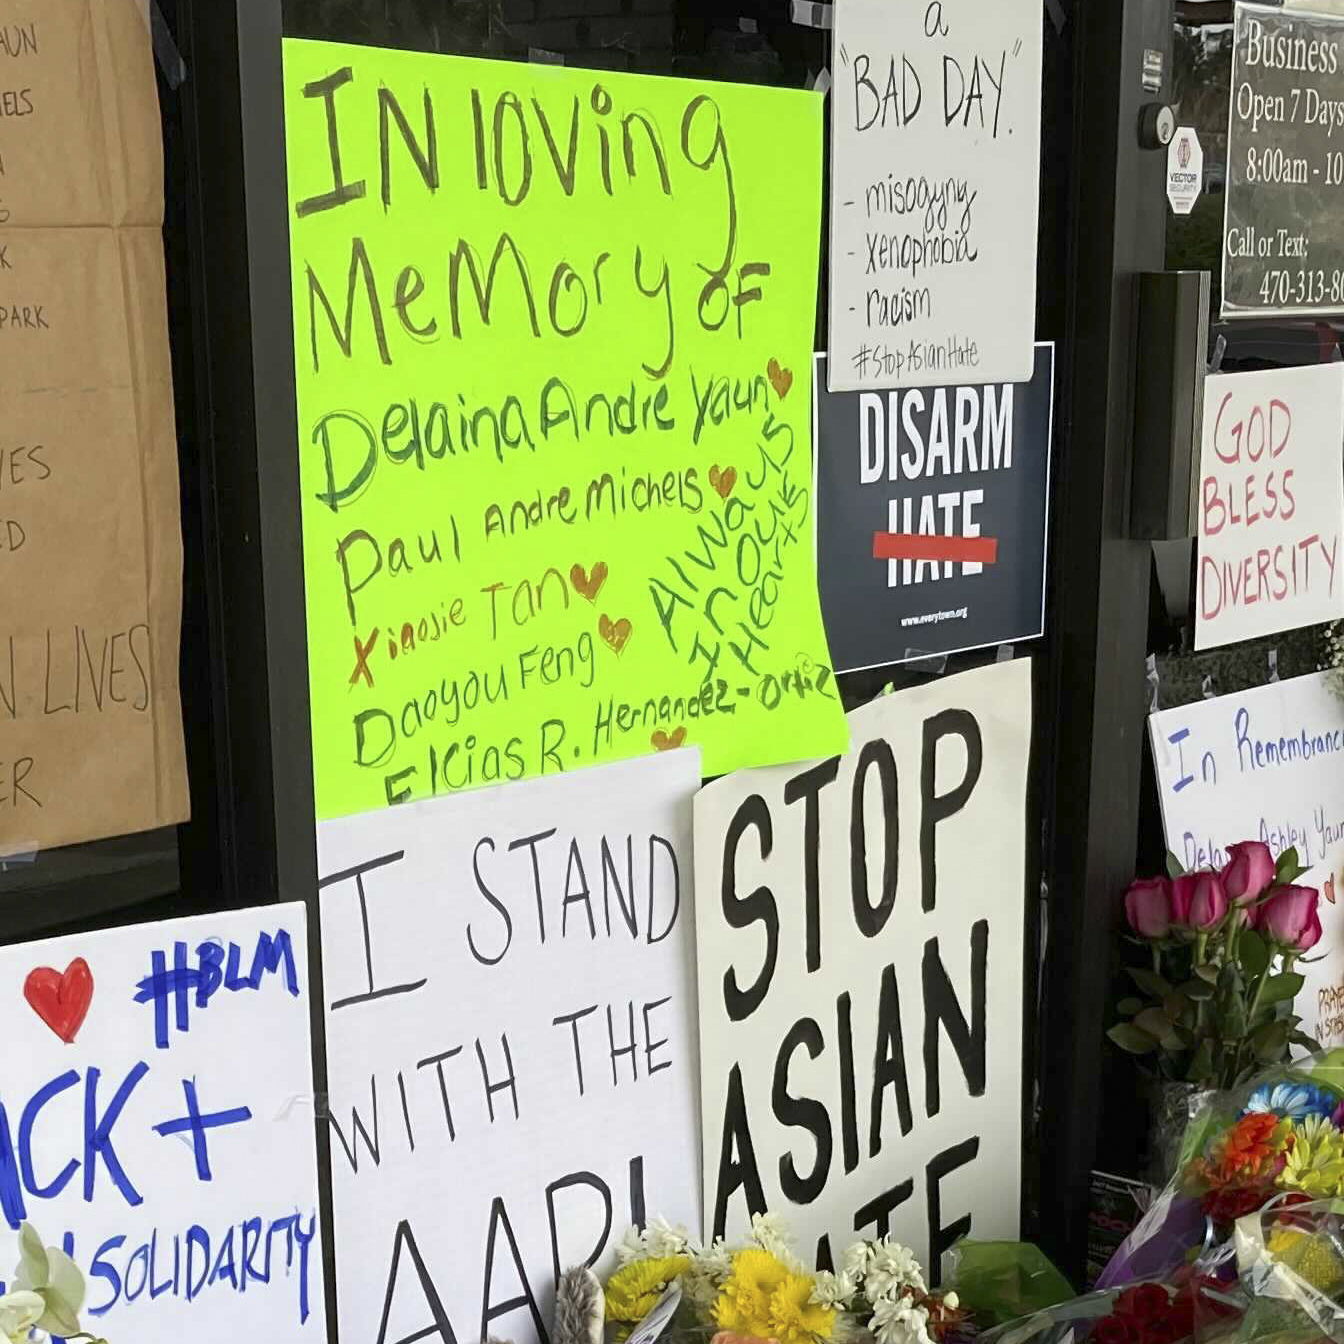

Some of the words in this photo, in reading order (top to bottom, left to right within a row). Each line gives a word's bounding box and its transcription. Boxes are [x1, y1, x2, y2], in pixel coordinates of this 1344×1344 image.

[923, 1, 949, 37] a
[1245, 18, 1338, 75] Business
[1237, 82, 1285, 132] Open
[1290, 88, 1302, 122] 7
[1305, 88, 1344, 137] Days
[1169, 172, 1197, 184] VECTOR
[1246, 147, 1308, 184] 8:00am
[1227, 227, 1255, 257] Call
[1258, 234, 1273, 257] or
[1276, 228, 1309, 257] Text:
[866, 287, 931, 327] racism
[859, 384, 1014, 484] DISARM
[1214, 391, 1291, 464] GOD
[887, 489, 985, 588] HATE
[1203, 469, 1296, 536] BLESS
[483, 567, 571, 640] Tan
[1201, 534, 1338, 620] DIVERSITY
[41, 623, 151, 714] LIVES
[519, 631, 595, 688] Feng
[1167, 727, 1218, 793] In
[721, 707, 985, 1022] STOP
[317, 850, 428, 1012] I
[467, 827, 681, 966] STAND
[132, 927, 300, 1049] #BLM
[325, 1032, 521, 1174] WITH
[552, 996, 674, 1097] THE
[712, 918, 991, 1252] ASIAN
[87, 1206, 316, 1328] SOLIDARITY
